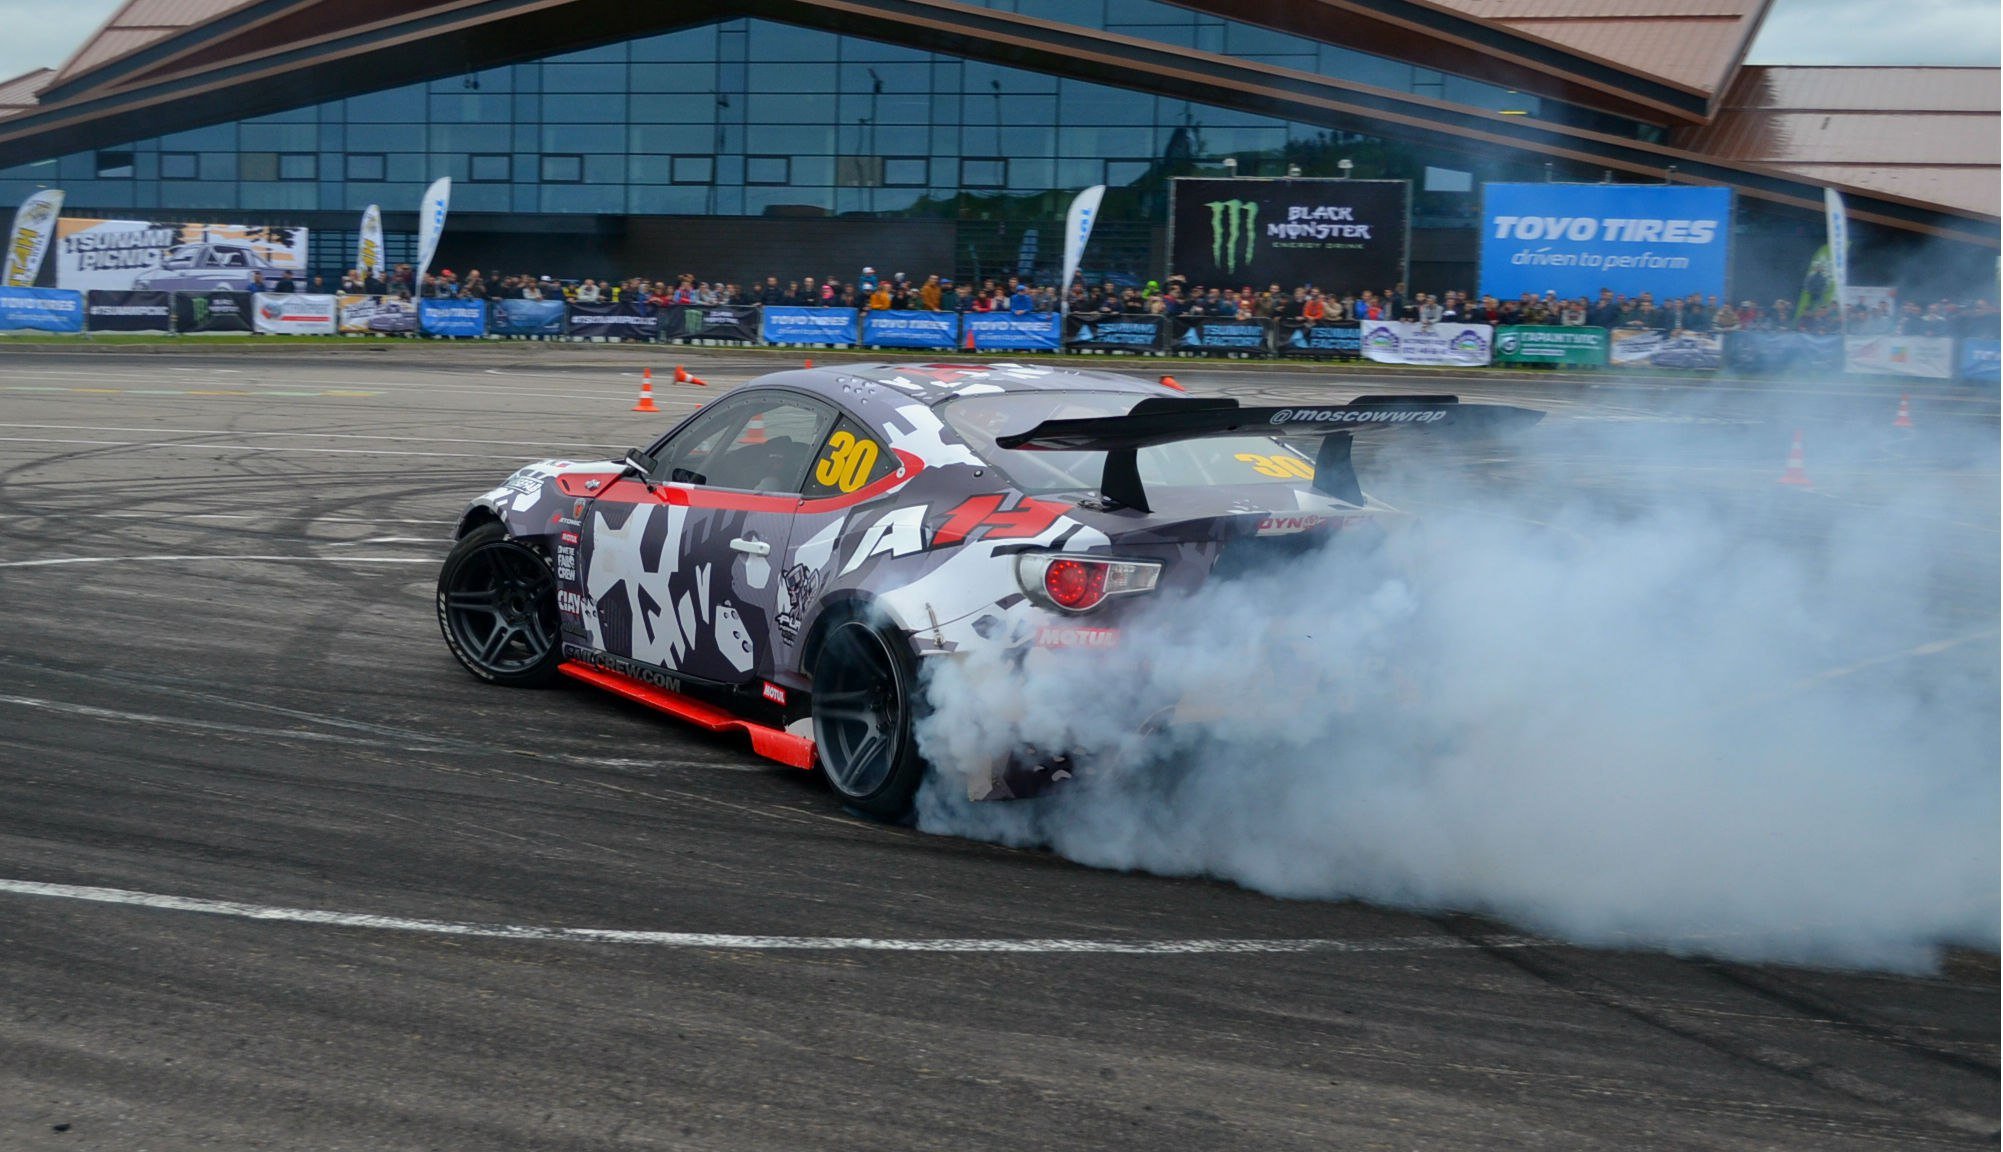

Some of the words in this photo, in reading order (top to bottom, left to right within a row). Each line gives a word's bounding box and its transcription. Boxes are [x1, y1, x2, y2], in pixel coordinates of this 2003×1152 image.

[1288, 206, 1353, 220] BLACK
[1267, 221, 1371, 239] MONSTER
[1494, 216, 1598, 241] TOYO
[1602, 218, 1717, 244] TIRES
[66, 229, 172, 252] TSUNAMI
[1511, 247, 1580, 266] driven
[1581, 251, 1600, 267] to
[1602, 252, 1689, 271] perform
[771, 316, 807, 325] TOYO
[808, 316, 849, 326] TIRES
[871, 318, 907, 328] TOYO
[971, 321, 1009, 331] TOYO
[1269, 409, 1448, 425] @moscowwrap
[815, 431, 879, 493] 30
[1234, 453, 1315, 480] 30
[1040, 628, 1116, 646] MOTUL
[763, 684, 785, 703] MOTUL
